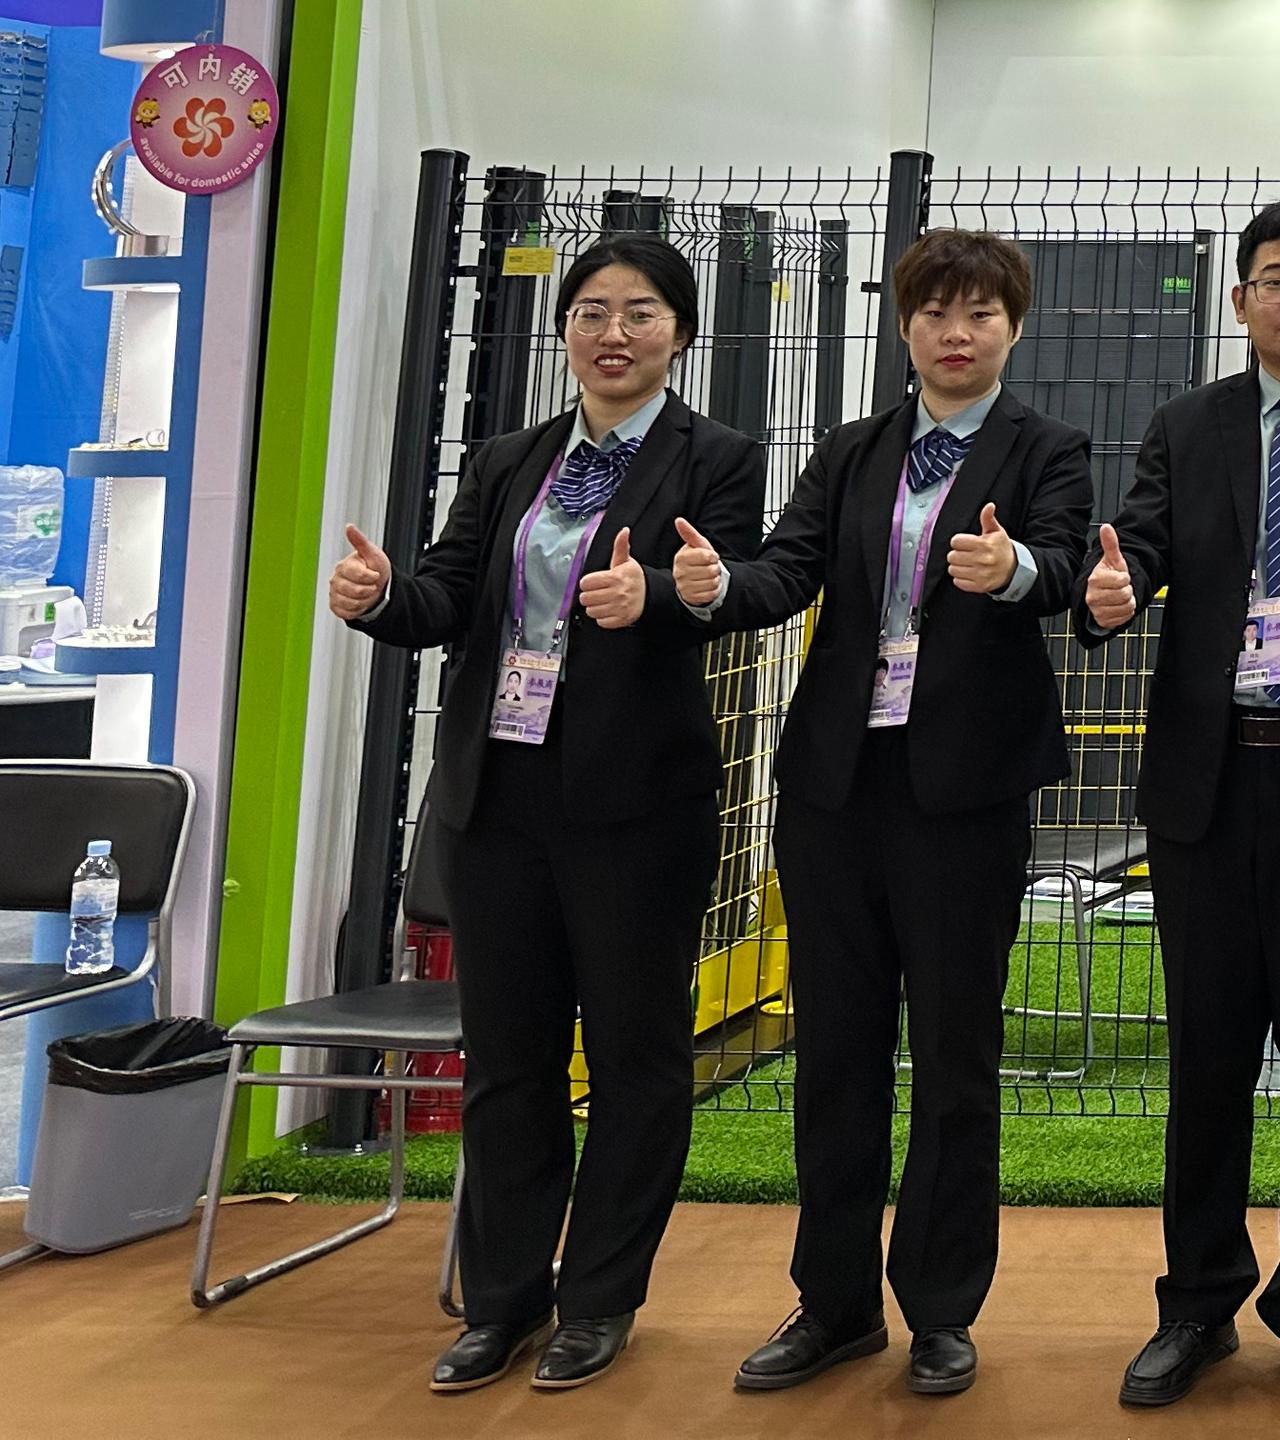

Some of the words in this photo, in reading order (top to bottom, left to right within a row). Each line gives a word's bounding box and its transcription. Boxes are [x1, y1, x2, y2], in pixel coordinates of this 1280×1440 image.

[158, 53, 260, 96] 可内销
[140, 137, 173, 179] available
[173, 174, 191, 187] for
[191, 166, 242, 188] domestic
[240, 142, 264, 170] sales
